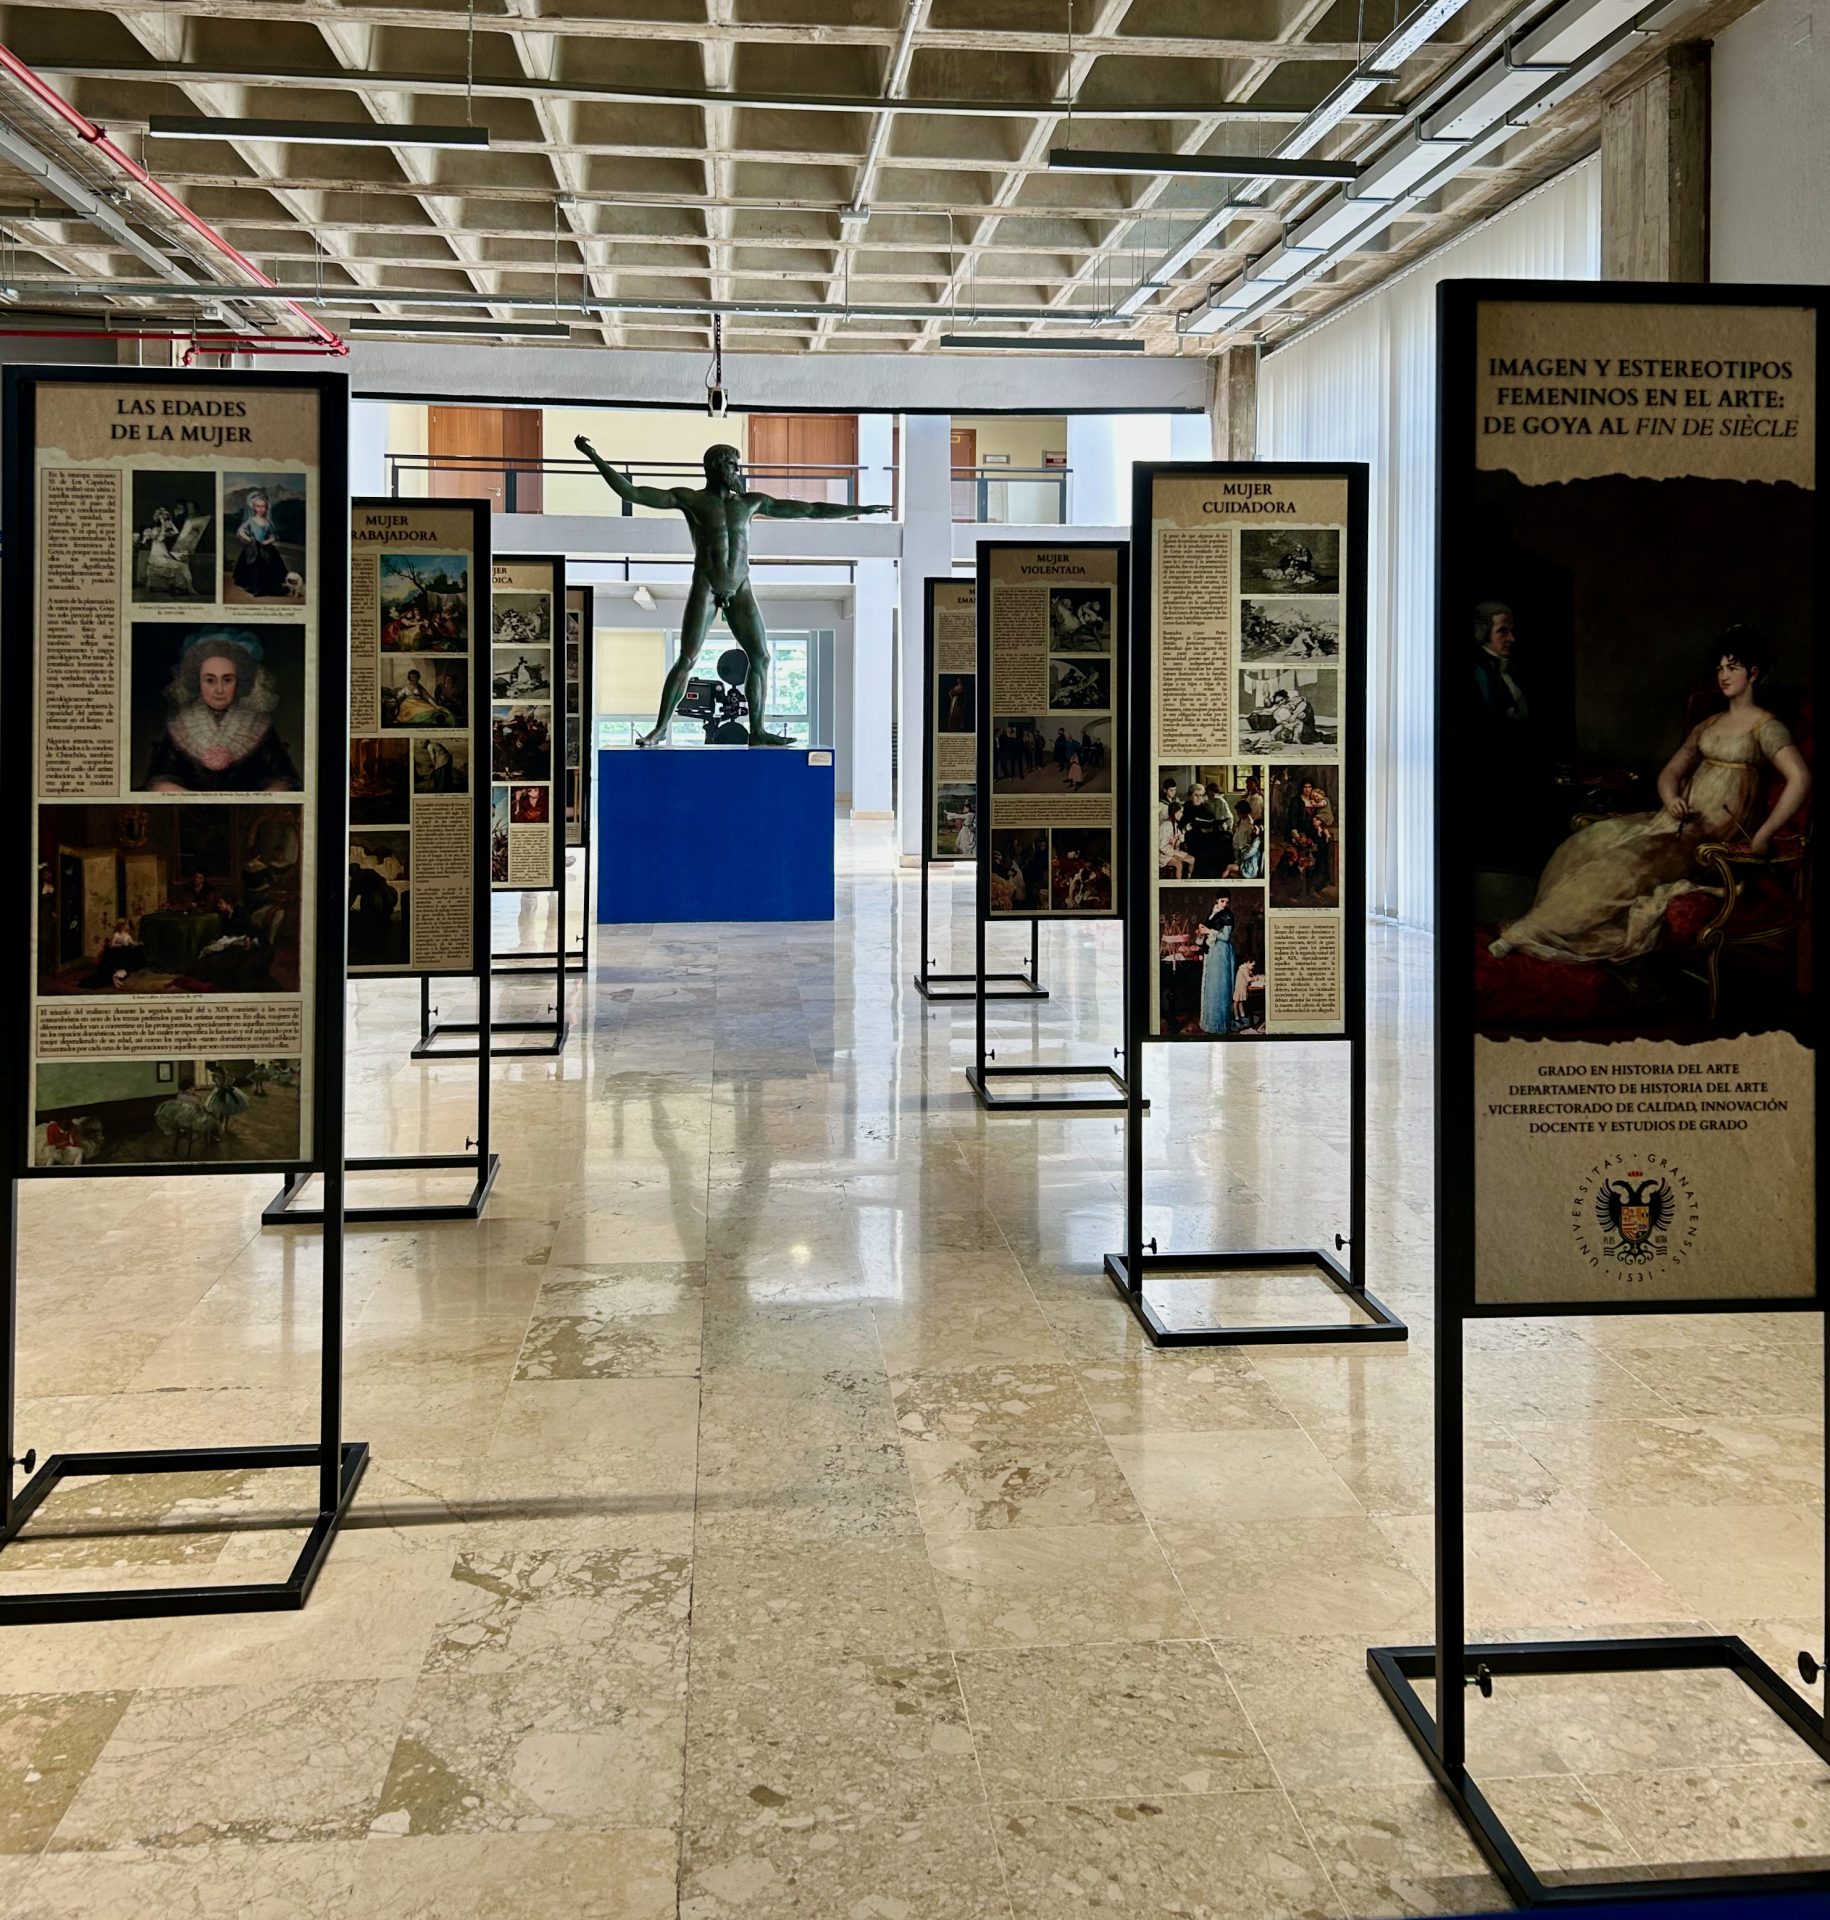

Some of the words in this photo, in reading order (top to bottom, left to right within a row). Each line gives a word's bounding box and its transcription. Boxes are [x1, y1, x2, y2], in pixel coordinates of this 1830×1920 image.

[1489, 357, 1587, 377] IMAGEN
[1594, 359, 1611, 377] Y
[1617, 359, 1793, 380] ESTEREOTIPOS
[1497, 387, 1639, 406] FEMENINOS
[1645, 388, 1677, 407] EN
[1684, 389, 1712, 407] EL
[1717, 390, 1785, 409] ARTE:
[117, 399, 156, 415] LAS
[162, 400, 247, 417] EDADES
[1483, 416, 1516, 435] DE
[1522, 416, 1593, 435] GOYA
[1598, 417, 1630, 435] AL
[1635, 417, 1677, 436] FIN
[1681, 418, 1715, 437] DE
[1719, 413, 1799, 438] SIÈCLE
[111, 424, 140, 440] DE
[146, 424, 174, 441] LA
[180, 425, 252, 448] MUJER
[1223, 483, 1273, 499] MUJER
[1202, 501, 1297, 513] CUIDADORA
[366, 515, 408, 529] MUJER
[352, 530, 438, 544] RABAJADORA
[1037, 554, 1069, 565] MUJER
[1021, 566, 1086, 574] VIOLENTADA
[492, 576, 513, 584] OICA
[1538, 1065, 1587, 1076] GRADO
[1590, 1065, 1608, 1075] EN
[1612, 1064, 1674, 1075] HISTORIA
[1678, 1064, 1703, 1074] DEL
[1706, 1064, 1740, 1074] ARTE
[1509, 1084, 1615, 1095] DEPARTAMENTO
[1619, 1083, 1637, 1094] DE
[1640, 1083, 1703, 1094] HISTORIA
[1706, 1083, 1732, 1093] DEL
[1735, 1082, 1768, 1093] ARTE
[1488, 1102, 1612, 1115] VICERRECTORADO
[1616, 1103, 1634, 1113] DE
[1637, 1102, 1698, 1113] CALIDAD,
[1701, 1098, 1788, 1111] INNOVACIÓN
[1529, 1122, 1594, 1133] DOCENTE
[1598, 1122, 1607, 1132] Y
[1611, 1121, 1676, 1131] ESTUDIOS
[1679, 1121, 1697, 1130] DE
[1699, 1119, 1748, 1130] GRADO
[1572, 1154, 1623, 1268] UNIVERSITAS
[1647, 1153, 1699, 1265] GRANATENSIS
[1618, 1271, 1653, 1282] 1531
